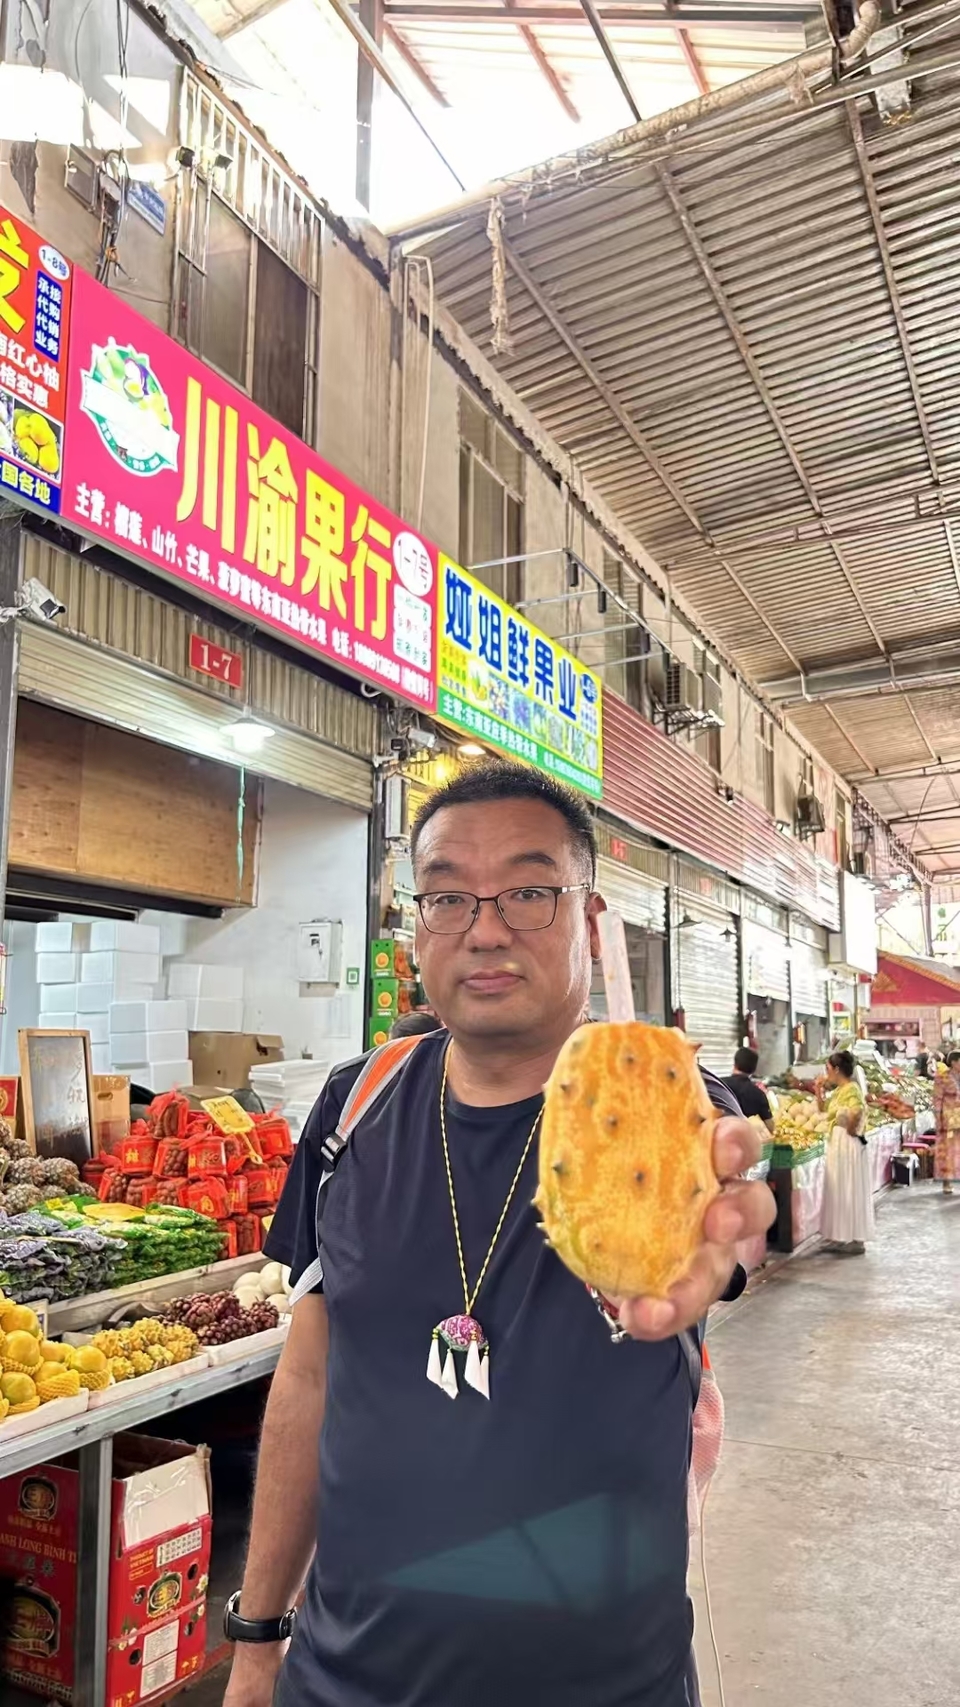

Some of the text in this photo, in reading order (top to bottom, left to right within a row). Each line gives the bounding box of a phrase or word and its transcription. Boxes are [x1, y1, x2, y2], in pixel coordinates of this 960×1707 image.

[0, 458, 50, 504] 国各地
[176, 375, 392, 641] 川渝果行
[200, 644, 232, 680] 1-7
[446, 567, 576, 721] 娅姐鲜果业
